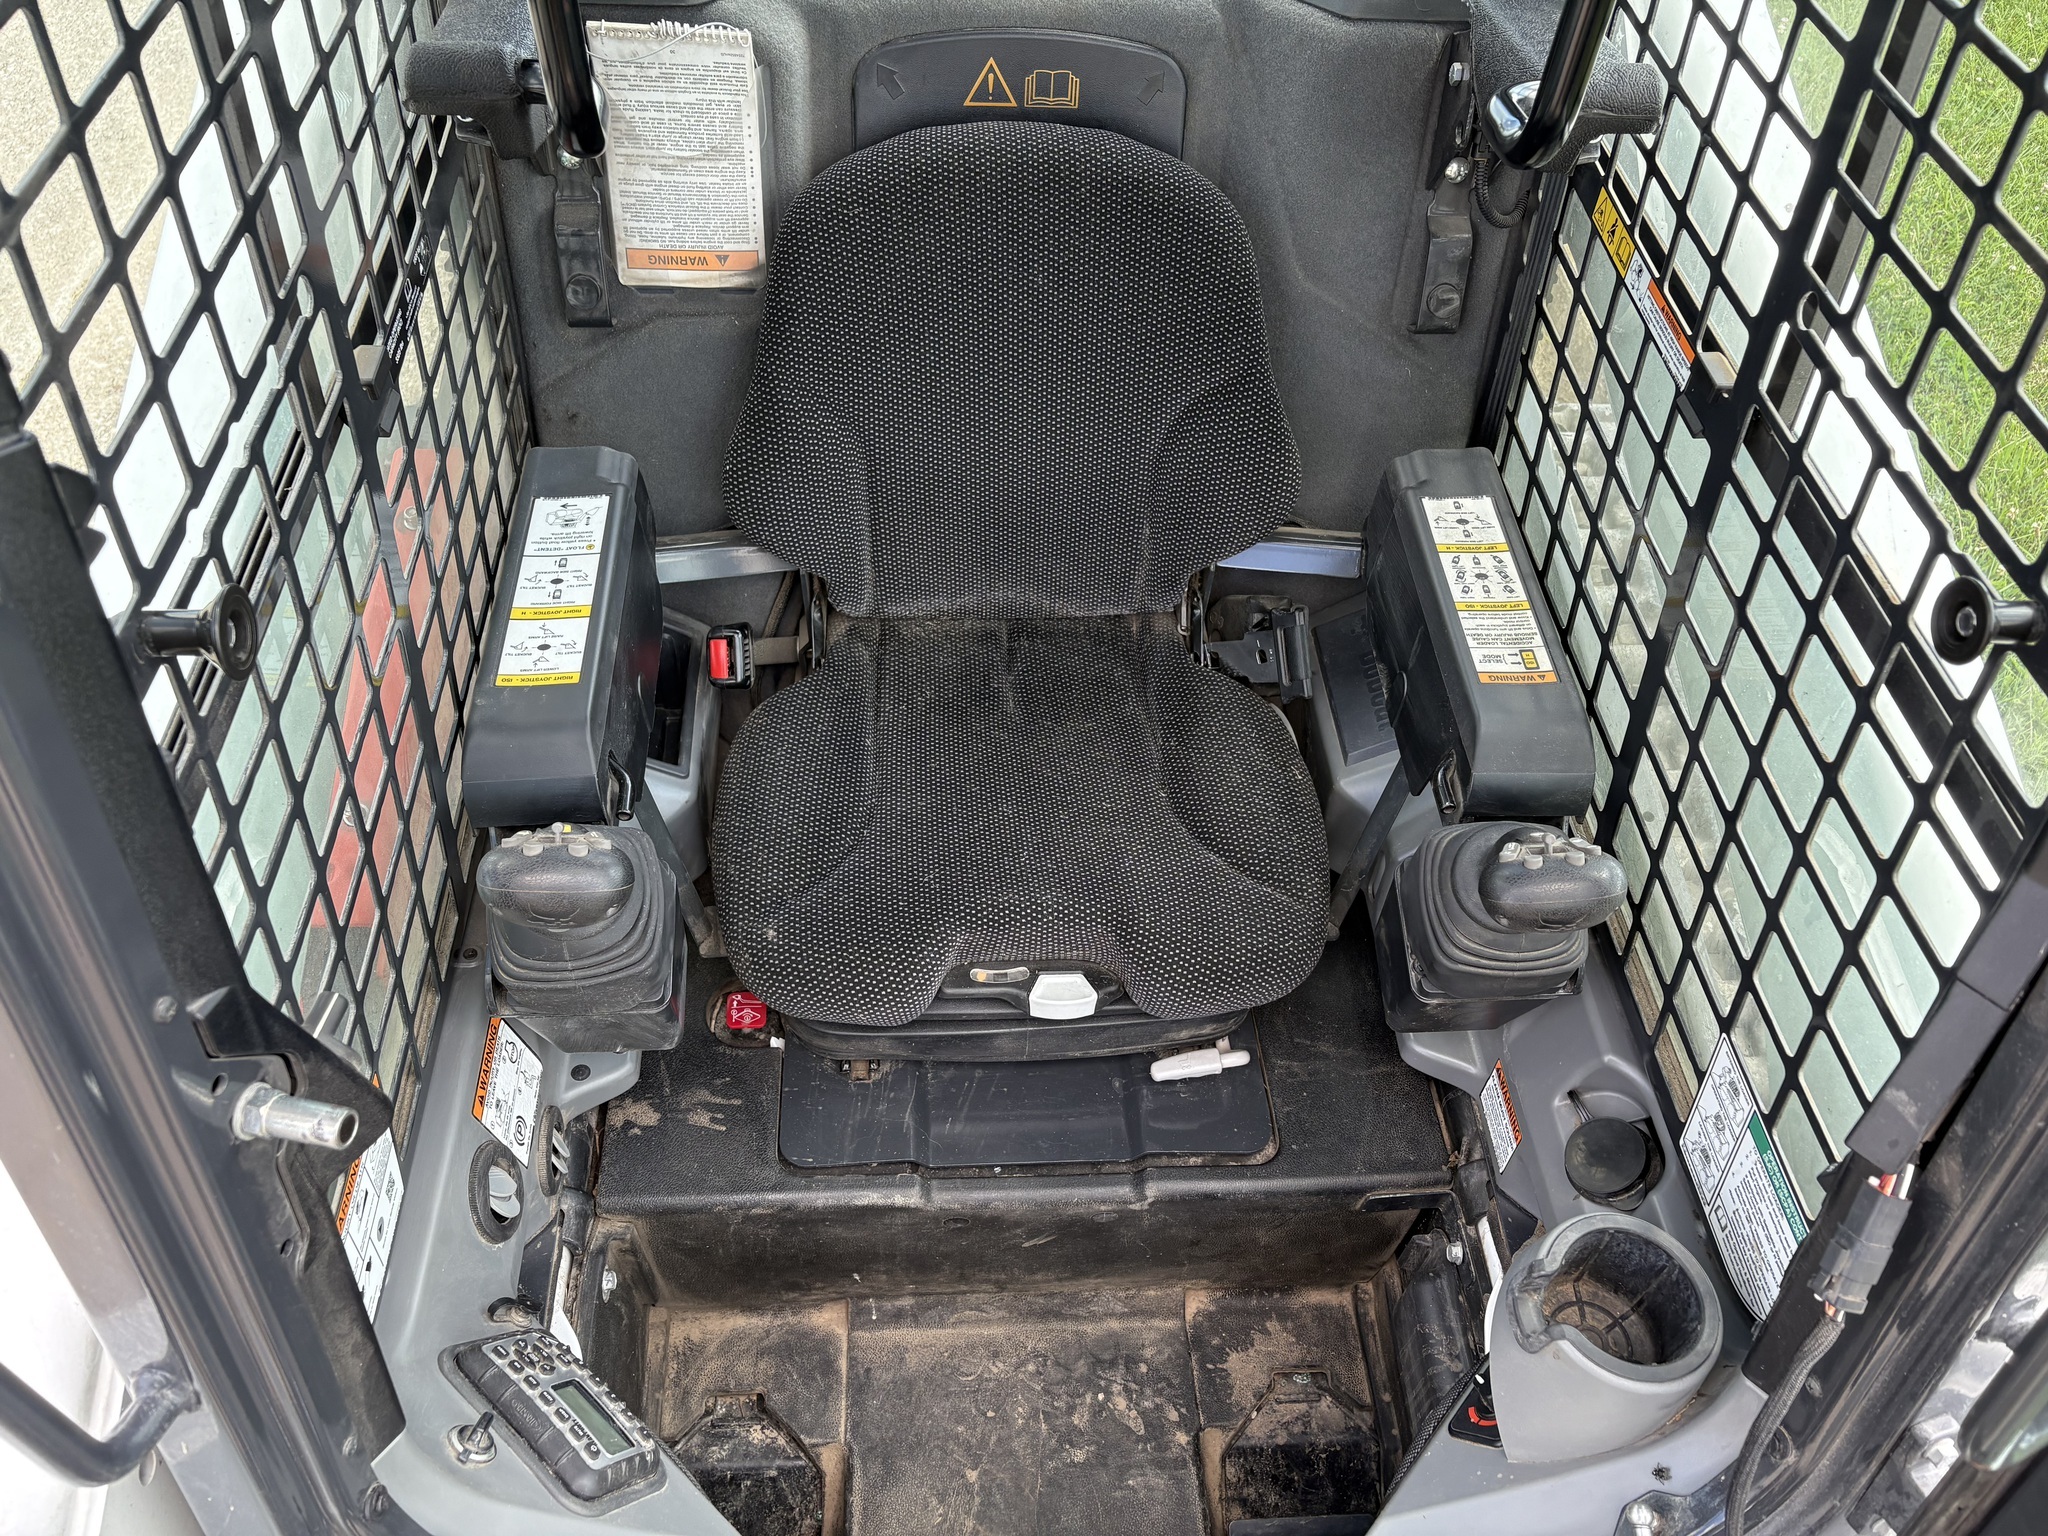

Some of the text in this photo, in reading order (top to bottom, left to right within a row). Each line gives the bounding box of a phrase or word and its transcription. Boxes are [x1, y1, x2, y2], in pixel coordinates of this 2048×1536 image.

[647, 255, 708, 266] WARNING
[479, 1024, 497, 1090] WARNING
[489, 1101, 493, 1109] TO
[496, 1042, 504, 1065] LOADER:
[516, 1124, 523, 1136] P
[1500, 1076, 1521, 1144] WARNING
[338, 1157, 361, 1226] ARNING
[1767, 1150, 1807, 1239] OPERATION INSTRUCT
[1790, 1217, 1803, 1244] CONT
